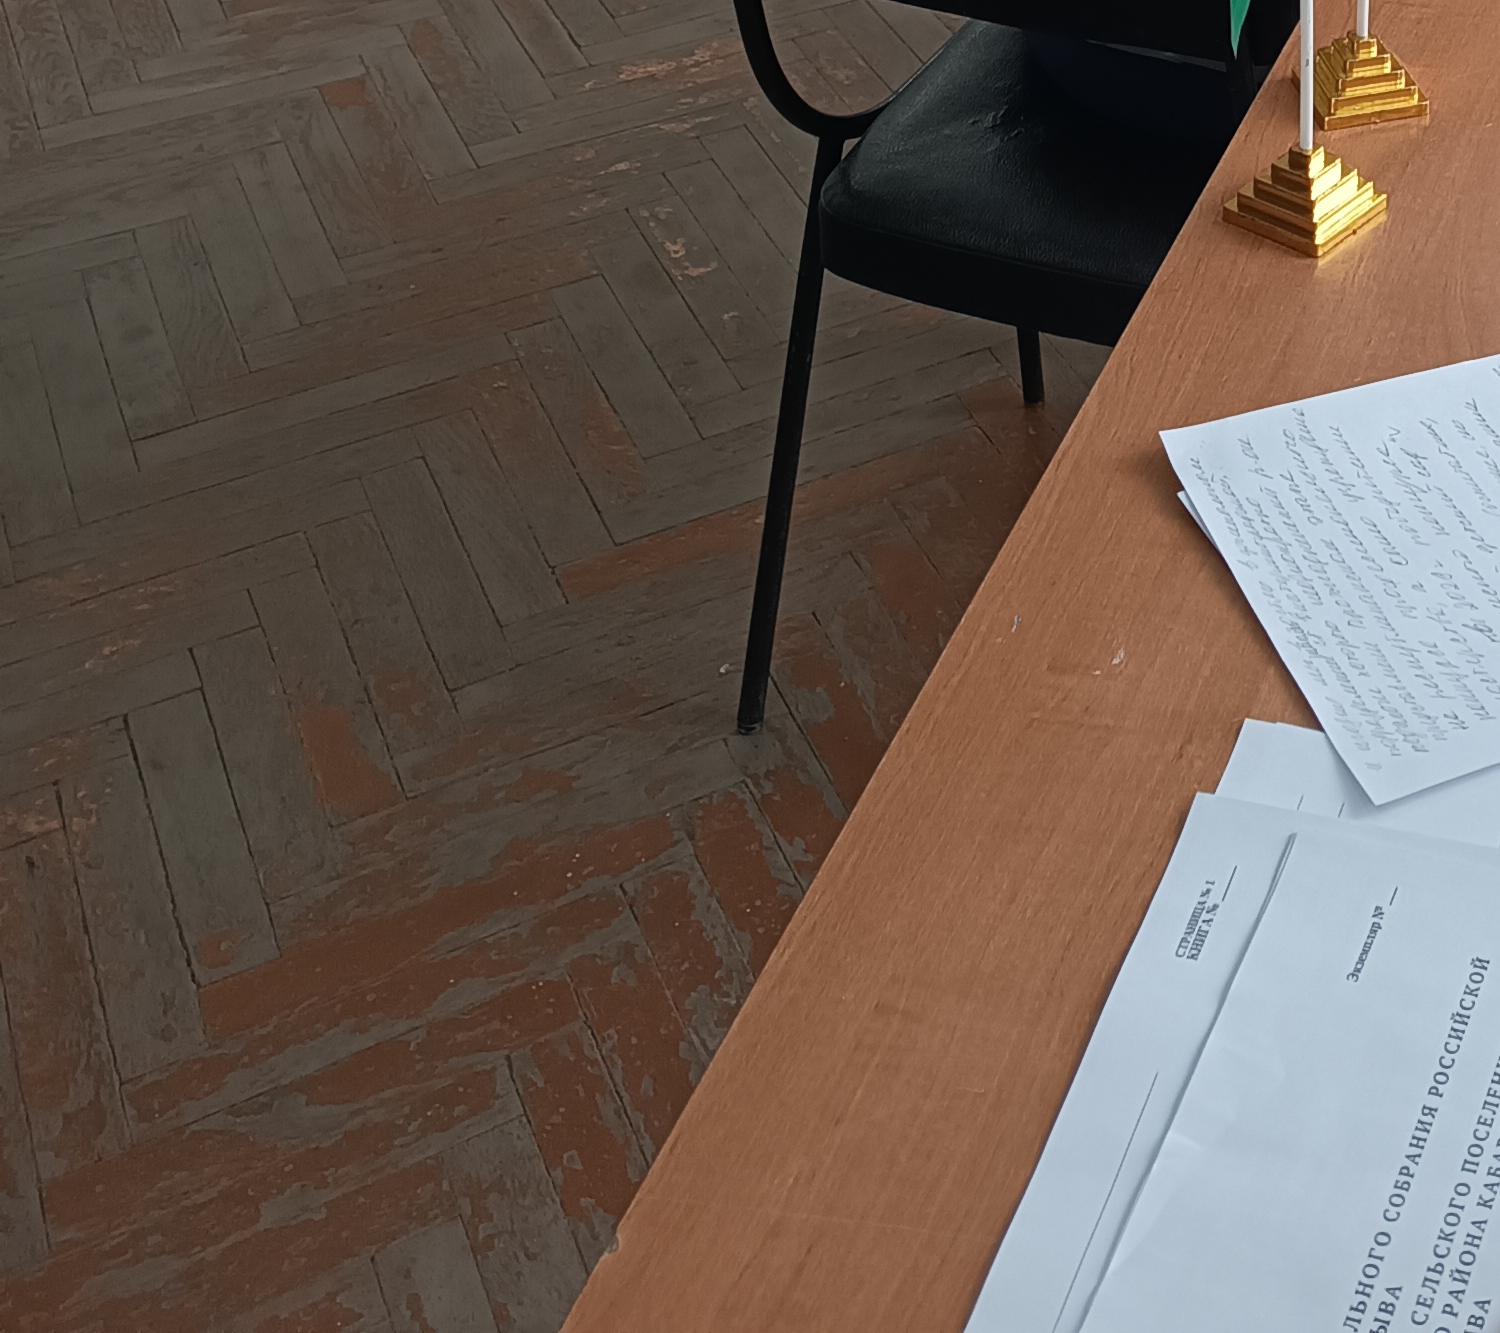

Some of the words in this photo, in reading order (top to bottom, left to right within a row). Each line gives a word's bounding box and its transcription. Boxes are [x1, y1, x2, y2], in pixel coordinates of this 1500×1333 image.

[1175, 900, 1208, 958] СТРАНИЦА
[1186, 918, 1214, 961] КНИГА
[1346, 921, 1382, 983] Экземпляр
[1371, 905, 1385, 920] №
[1342, 1231, 1392, 1333] ЛЬНОГО
[1382, 1104, 1439, 1222] СОБРАНИЯ
[1427, 956, 1490, 1098] РОССИЙСКОЙ
[1411, 1182, 1471, 1326] СЕЛЬСКОГО
[1441, 1219, 1488, 1318] РАЙОНА
